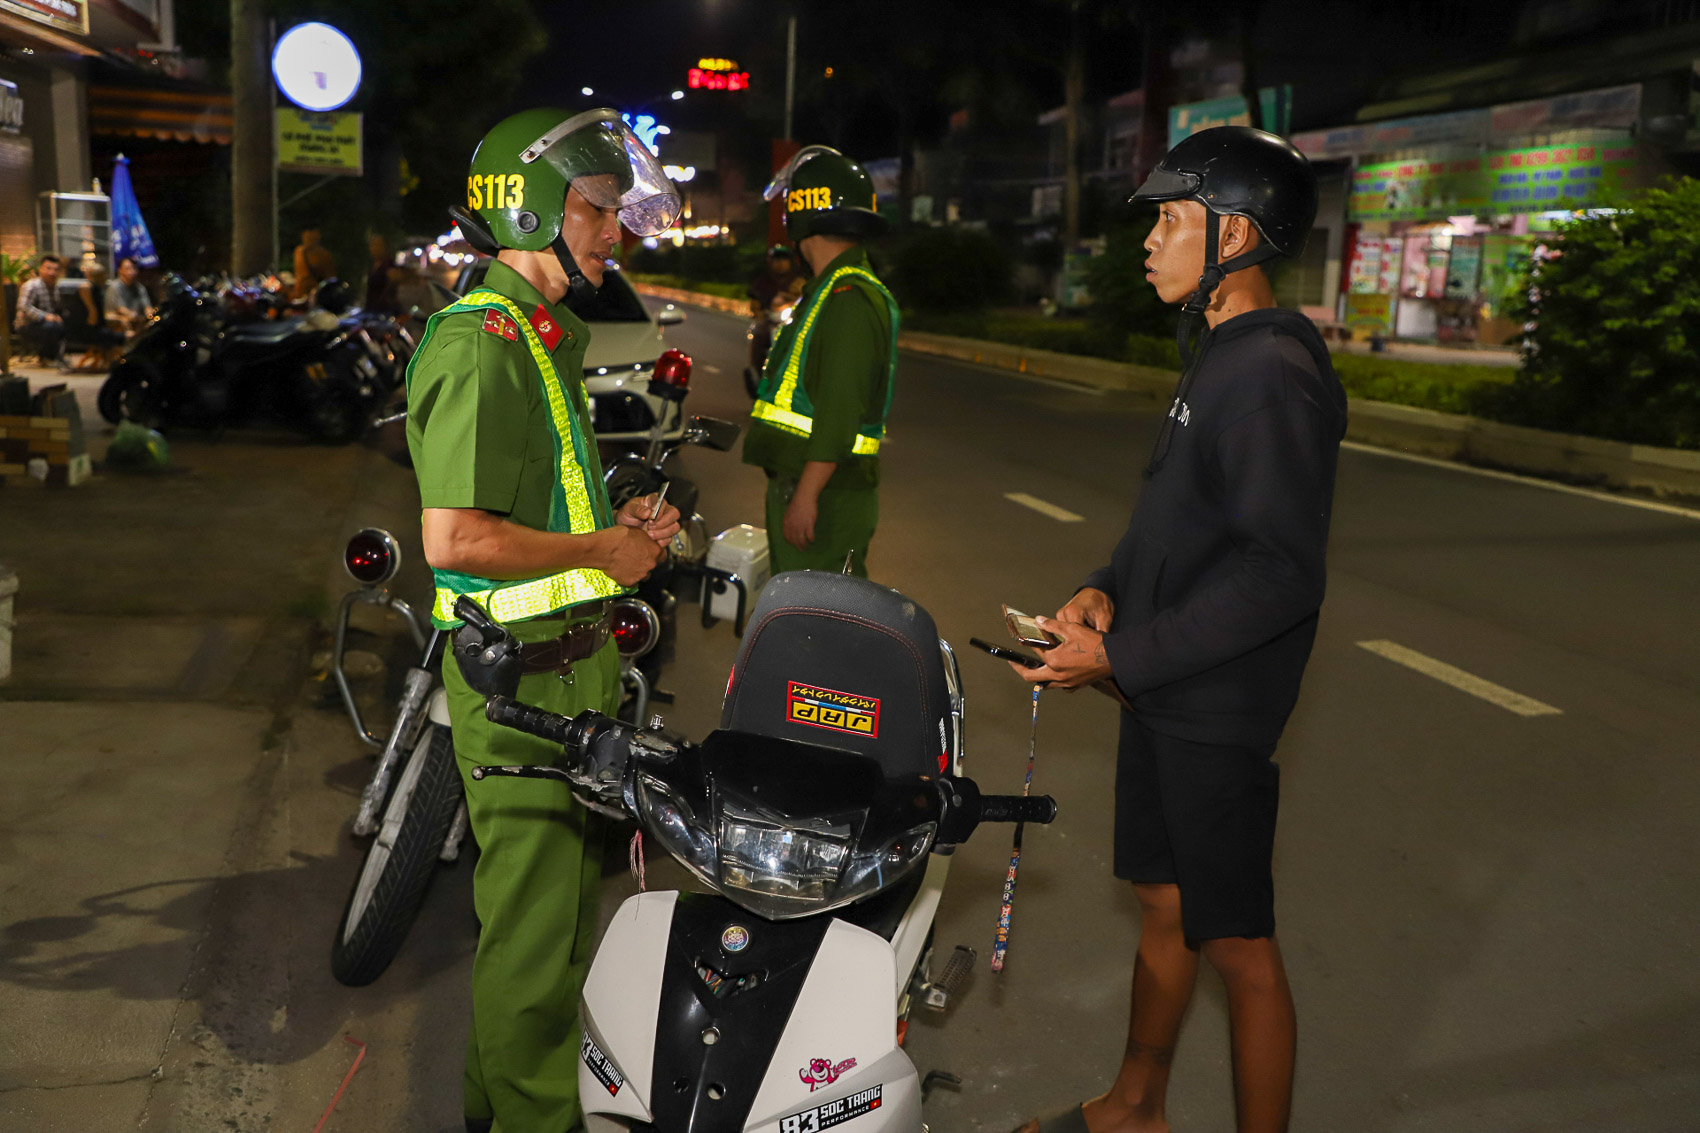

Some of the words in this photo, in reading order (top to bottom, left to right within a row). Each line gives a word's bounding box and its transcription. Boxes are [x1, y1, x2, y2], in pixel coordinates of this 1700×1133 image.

[467, 174, 525, 211] CS113
[788, 186, 831, 213] CS113
[797, 708, 868, 727] JRP
[590, 1045, 604, 1066] SOC
[601, 1058, 623, 1087] TRANG
[781, 1107, 820, 1133] 83
[820, 1099, 845, 1119] SOC
[847, 1086, 881, 1109] TRANG
[821, 1105, 870, 1127] PERFORMANCE
